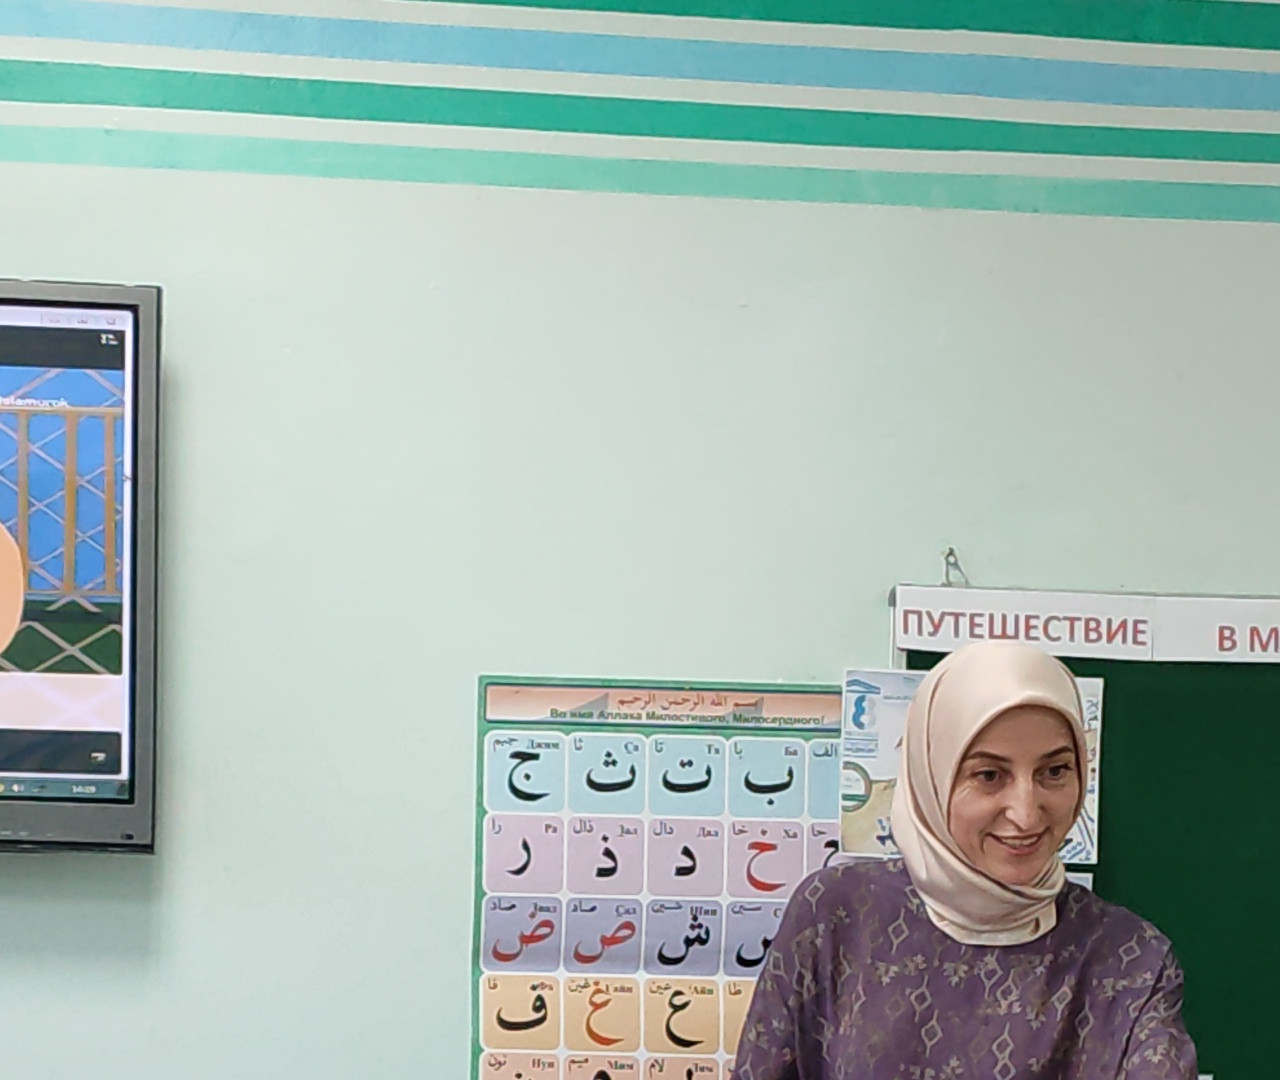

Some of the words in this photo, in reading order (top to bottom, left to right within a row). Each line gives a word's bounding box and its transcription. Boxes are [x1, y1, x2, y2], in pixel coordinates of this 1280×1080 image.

[901, 608, 1149, 647] ПУТЕШЕСТВИЕ
[1217, 625, 1238, 653] В
[596, 709, 644, 721] Аллаха
